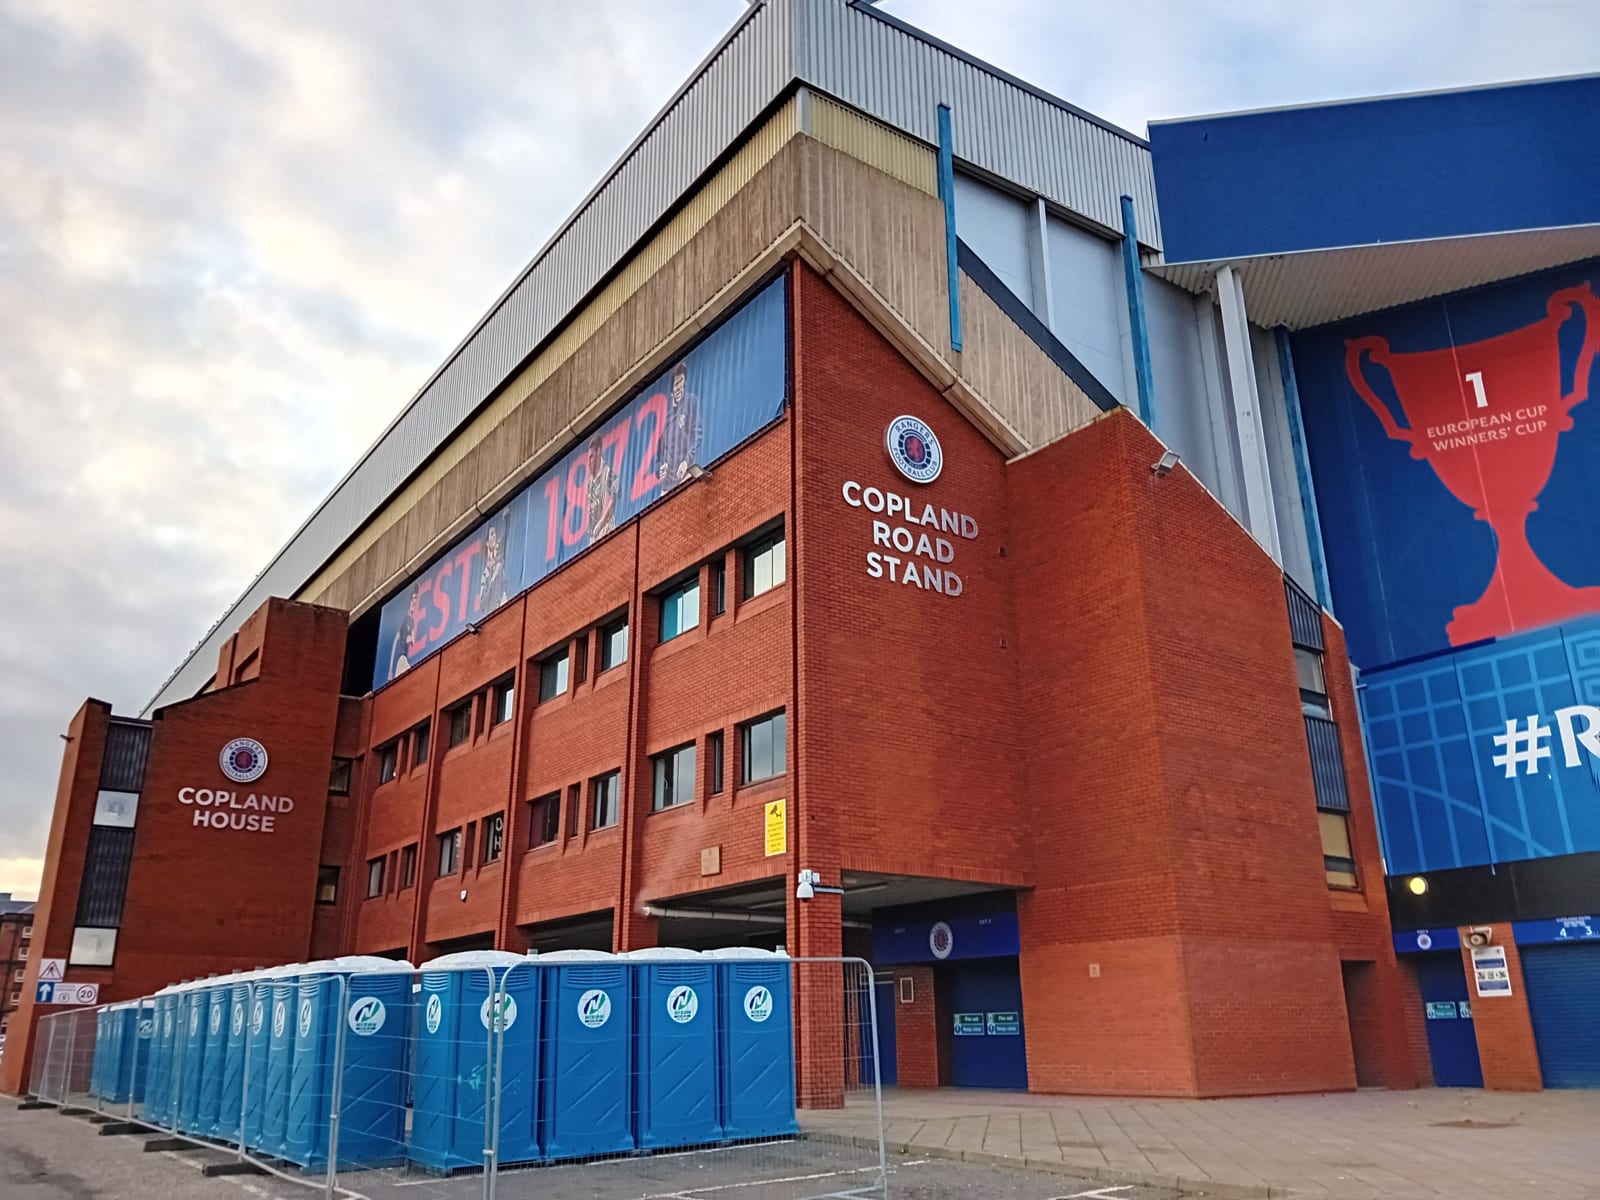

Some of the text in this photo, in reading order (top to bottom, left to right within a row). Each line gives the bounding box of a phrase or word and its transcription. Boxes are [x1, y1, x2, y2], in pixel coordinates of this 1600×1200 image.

[1466, 371, 1488, 409] 1
[895, 420, 934, 445] RANGERS
[1427, 405, 1547, 438] EUROPEAN CUP
[1433, 421, 1547, 451] WINNERS' CUP
[544, 393, 668, 561] 1872
[842, 480, 979, 540] COPLAND
[872, 520, 955, 564] ROAD
[866, 551, 964, 597] STAND
[178, 787, 294, 813] COPLAND
[192, 810, 275, 833] HOUSE
[1559, 925, 1593, 938] 4 3
[80, 990, 93, 999] 20
